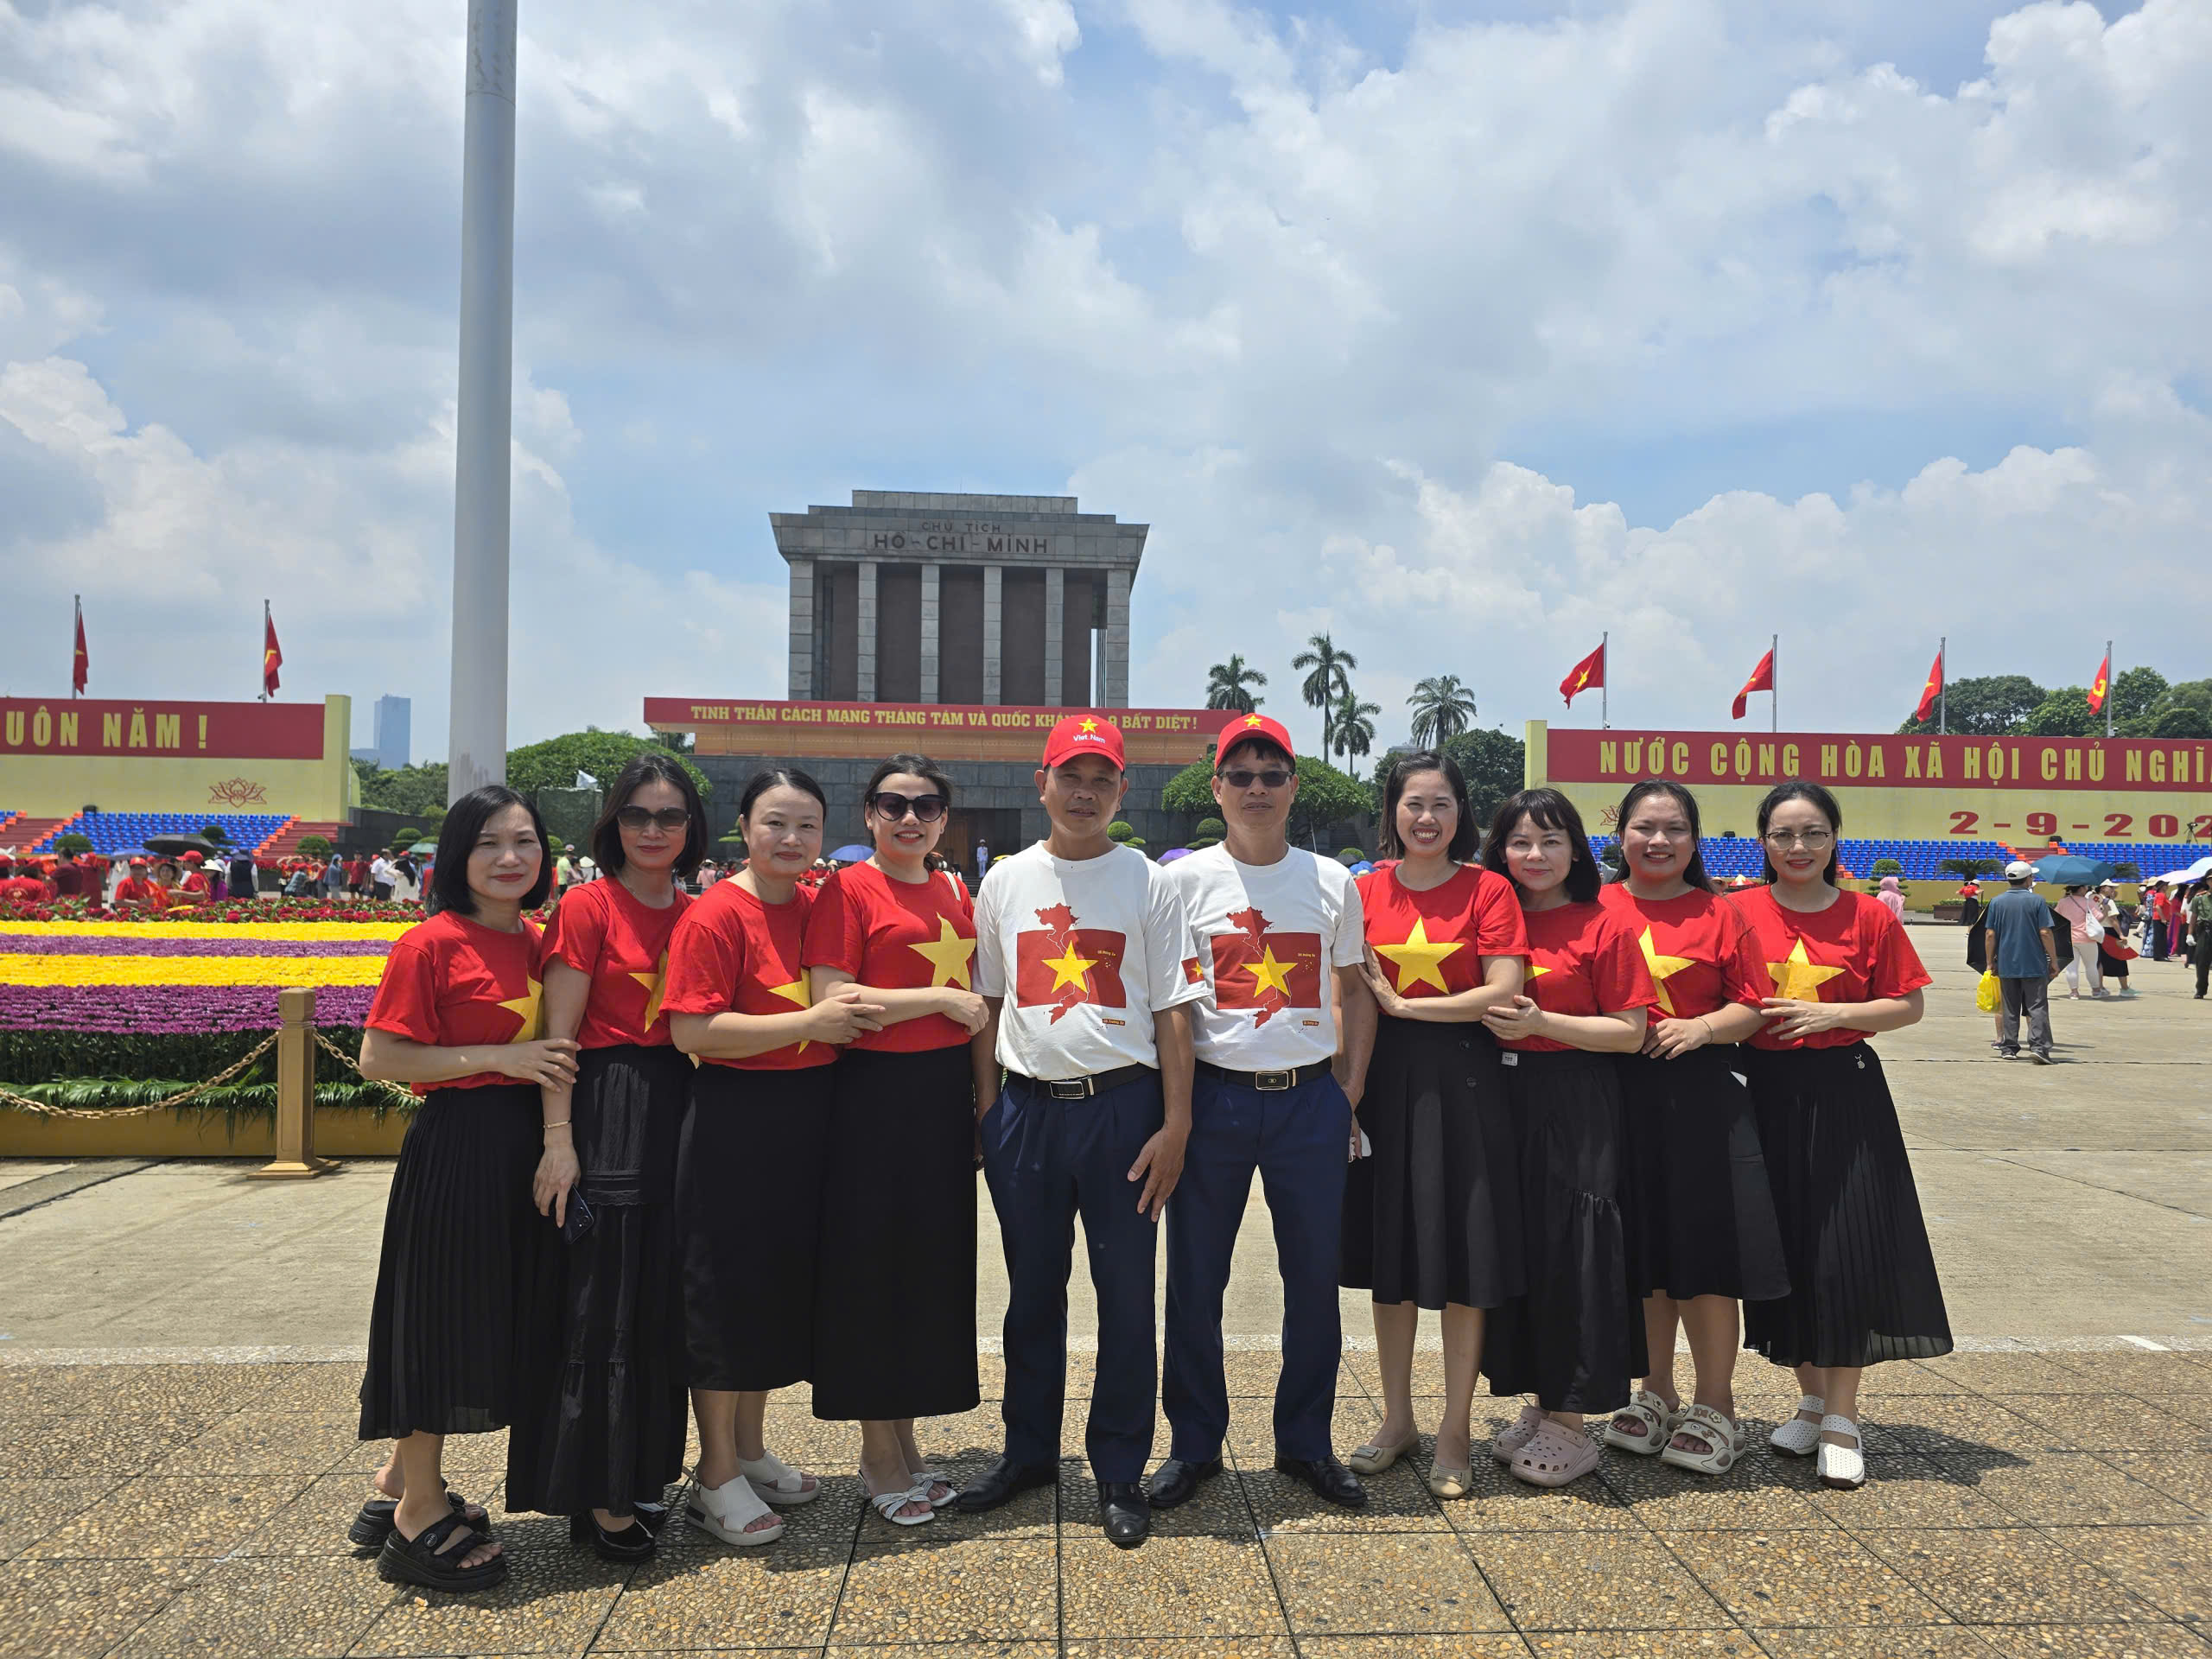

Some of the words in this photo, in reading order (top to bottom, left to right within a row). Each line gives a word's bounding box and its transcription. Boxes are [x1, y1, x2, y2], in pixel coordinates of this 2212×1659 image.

[5, 705, 79, 747] UÔN
[690, 705, 730, 720] TINH
[781, 705, 823, 722] CÁCH
[826, 709, 871, 726] MẠNG
[874, 708, 926, 725] THÁNG
[931, 709, 963, 726] TÁM
[967, 709, 988, 727] VÀ
[991, 709, 1031, 728] QUỐC
[1122, 711, 1152, 729] BẤT
[1600, 736, 1689, 776] NƯỚC
[1710, 737, 1800, 782] CỘNG
[1821, 740, 1885, 778] HÒA
[1904, 741, 1943, 779] XÃ
[1963, 741, 2020, 785] HỘI
[2040, 741, 2105, 782] CHỦ
[2126, 746, 2212, 783] NGHĨ
